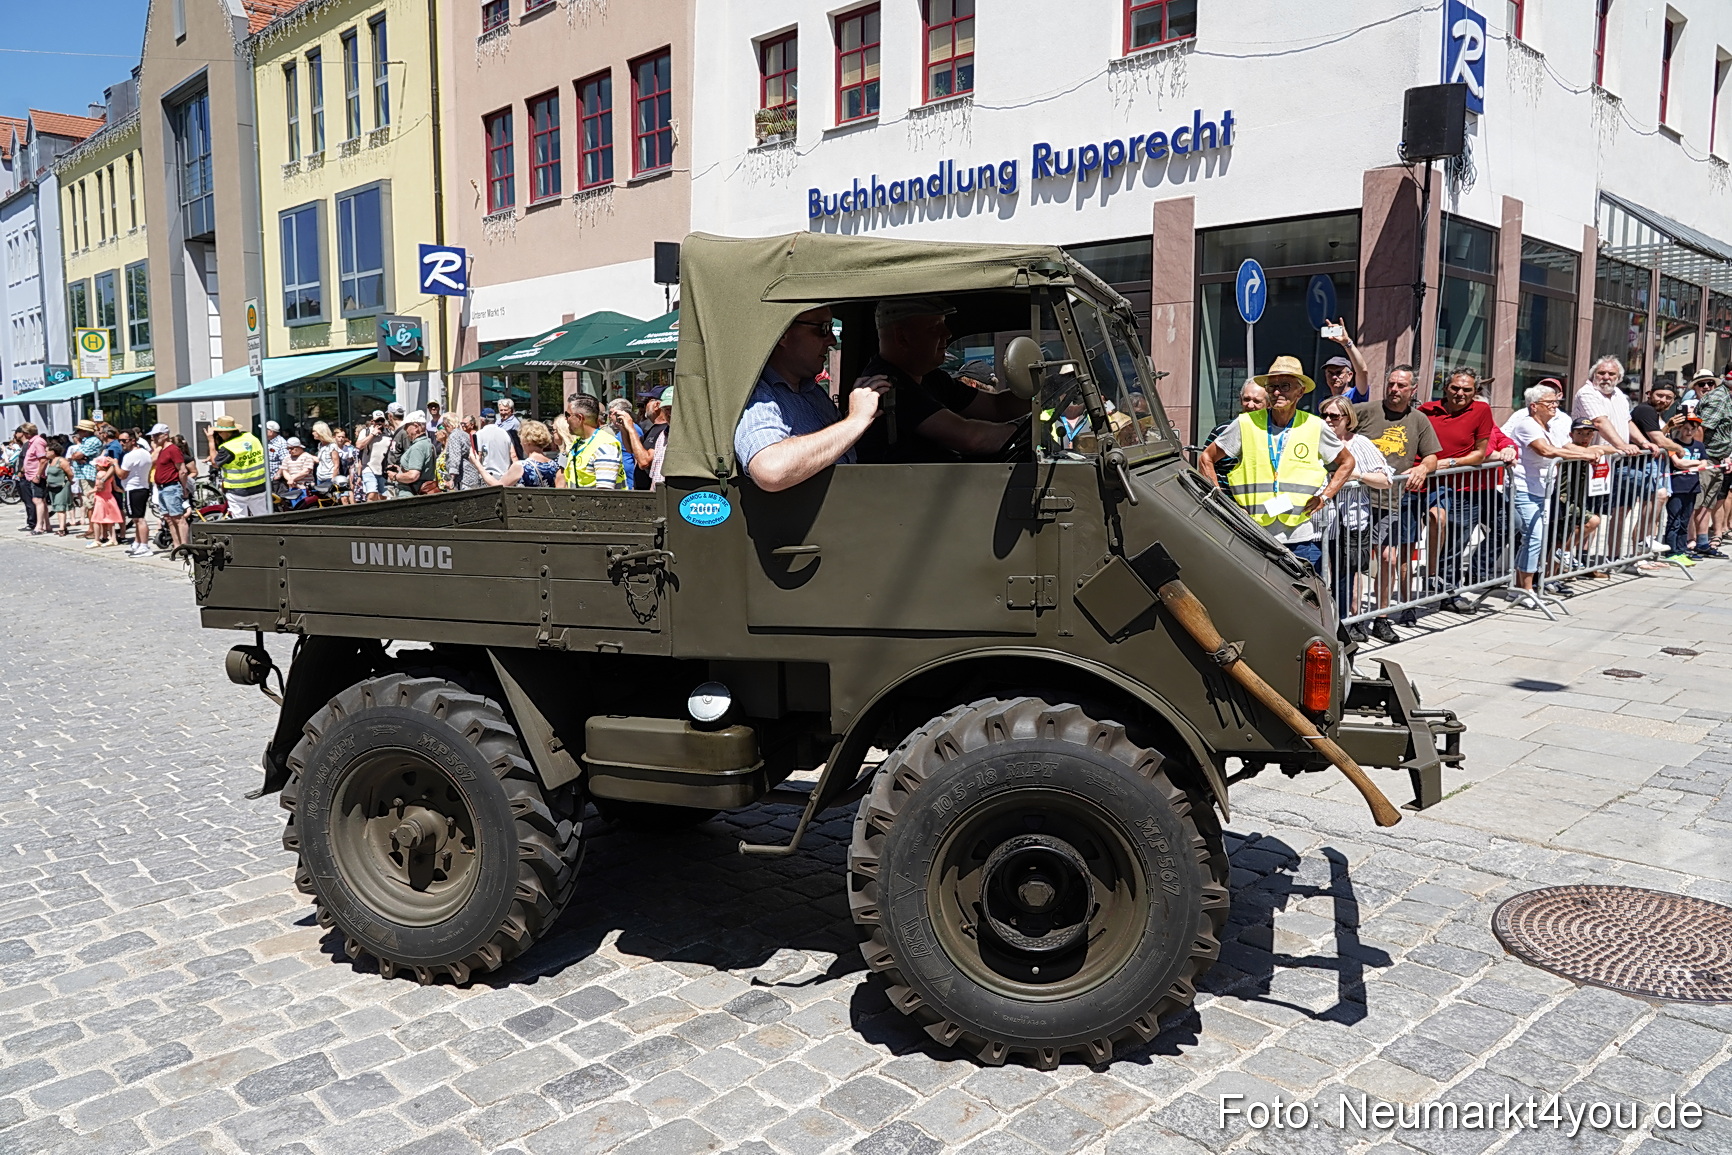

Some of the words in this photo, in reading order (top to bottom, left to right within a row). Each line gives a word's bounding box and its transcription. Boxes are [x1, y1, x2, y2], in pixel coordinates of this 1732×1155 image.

[808, 159, 1018, 219] Buchhandlung
[1032, 109, 1236, 183] Rupprecht
[487, 308, 500, 318] Markt
[396, 328, 412, 348] G2
[54, 371, 65, 381] G2
[689, 503, 721, 515] 2007
[350, 541, 453, 570] UNIMOG
[327, 733, 356, 765] MPT
[932, 768, 998, 819] 10.5-18
[1005, 762, 1059, 780] MPT
[1134, 815, 1181, 897] MP567
[343, 902, 370, 932] BKT
[902, 920, 930, 956] BKT
